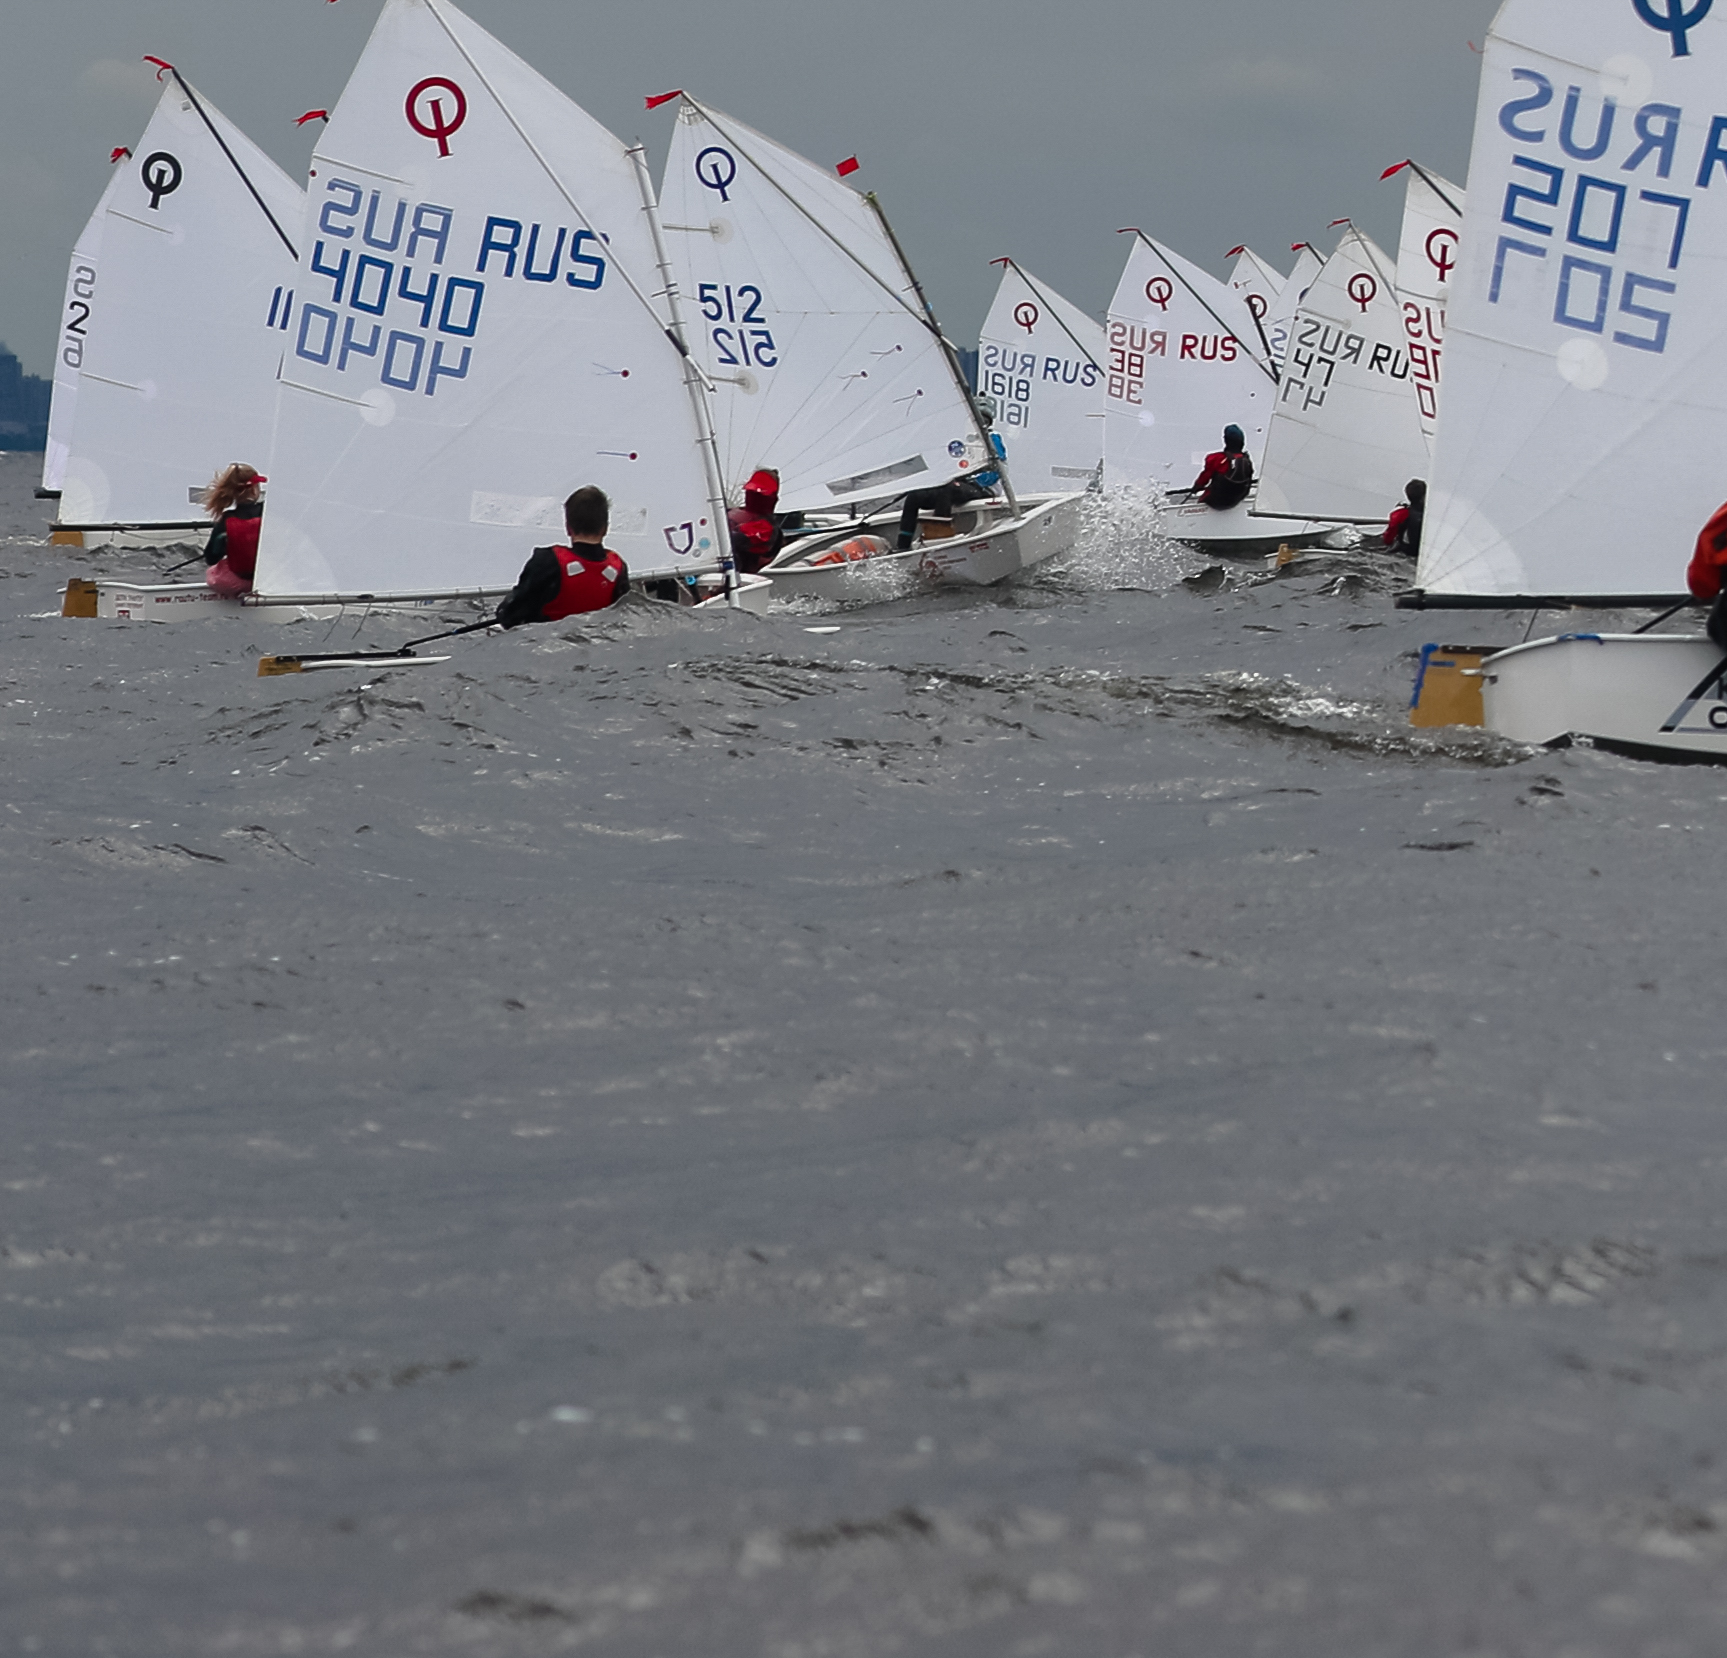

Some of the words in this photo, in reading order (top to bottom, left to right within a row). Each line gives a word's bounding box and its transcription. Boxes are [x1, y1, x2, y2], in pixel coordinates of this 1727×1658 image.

[1501, 154, 1691, 270] 207
[475, 216, 610, 290] RUS
[311, 240, 485, 337] 4040
[698, 283, 766, 324] 512
[1109, 348, 1144, 378] 38
[1179, 334, 1238, 362] RUS
[1293, 348, 1336, 387] 47
[1368, 342, 1413, 383] RU
[985, 370, 1030, 402] 1618
[1042, 357, 1097, 387] RUS
